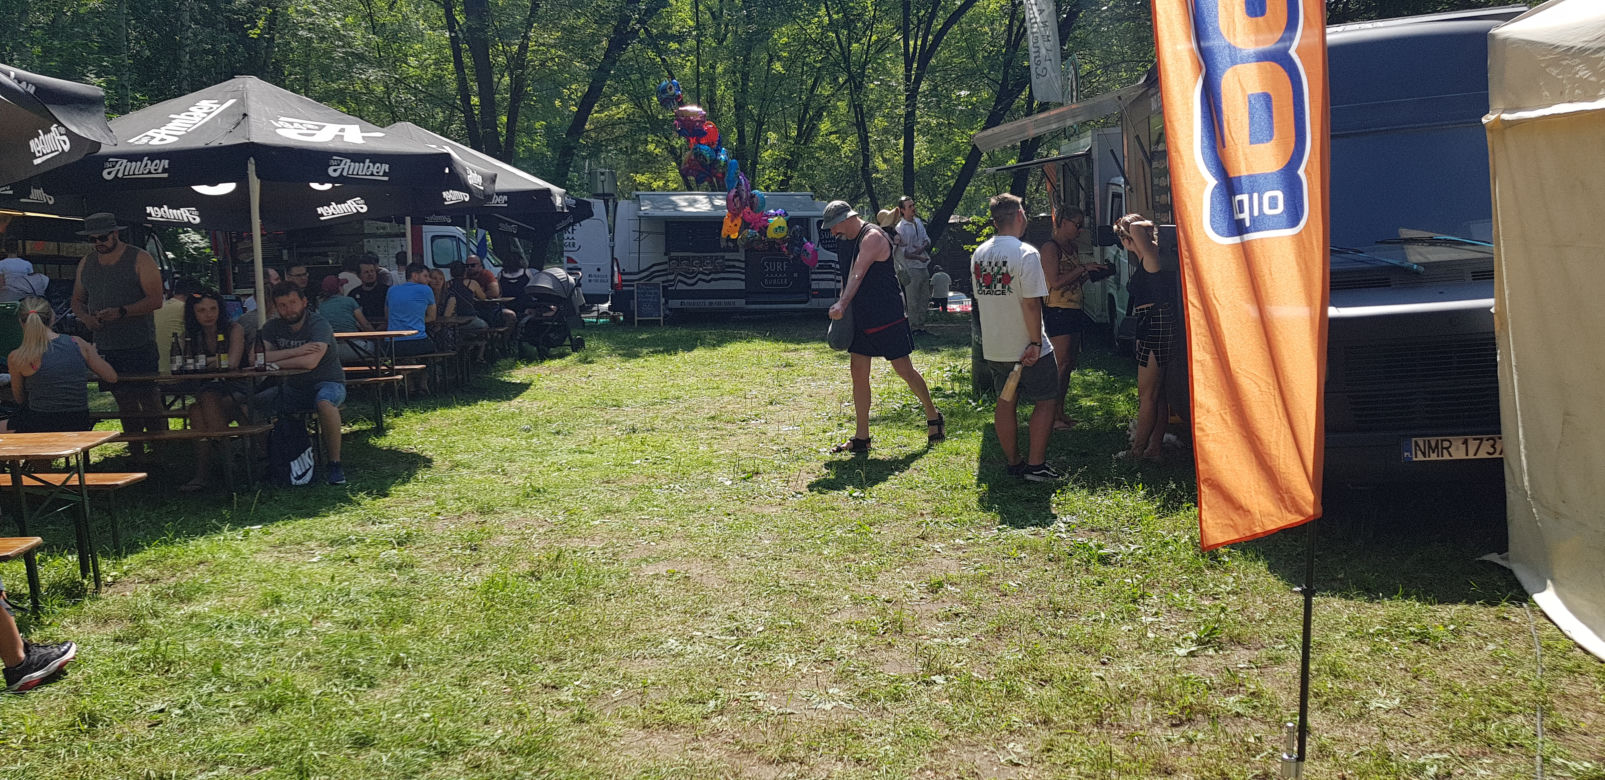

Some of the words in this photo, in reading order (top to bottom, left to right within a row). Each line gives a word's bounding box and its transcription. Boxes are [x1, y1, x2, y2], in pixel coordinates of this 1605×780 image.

[102, 156, 170, 180] Amber
[327, 156, 390, 179] Amber
[763, 261, 788, 272] SURF
[1414, 439, 1453, 459] NMR
